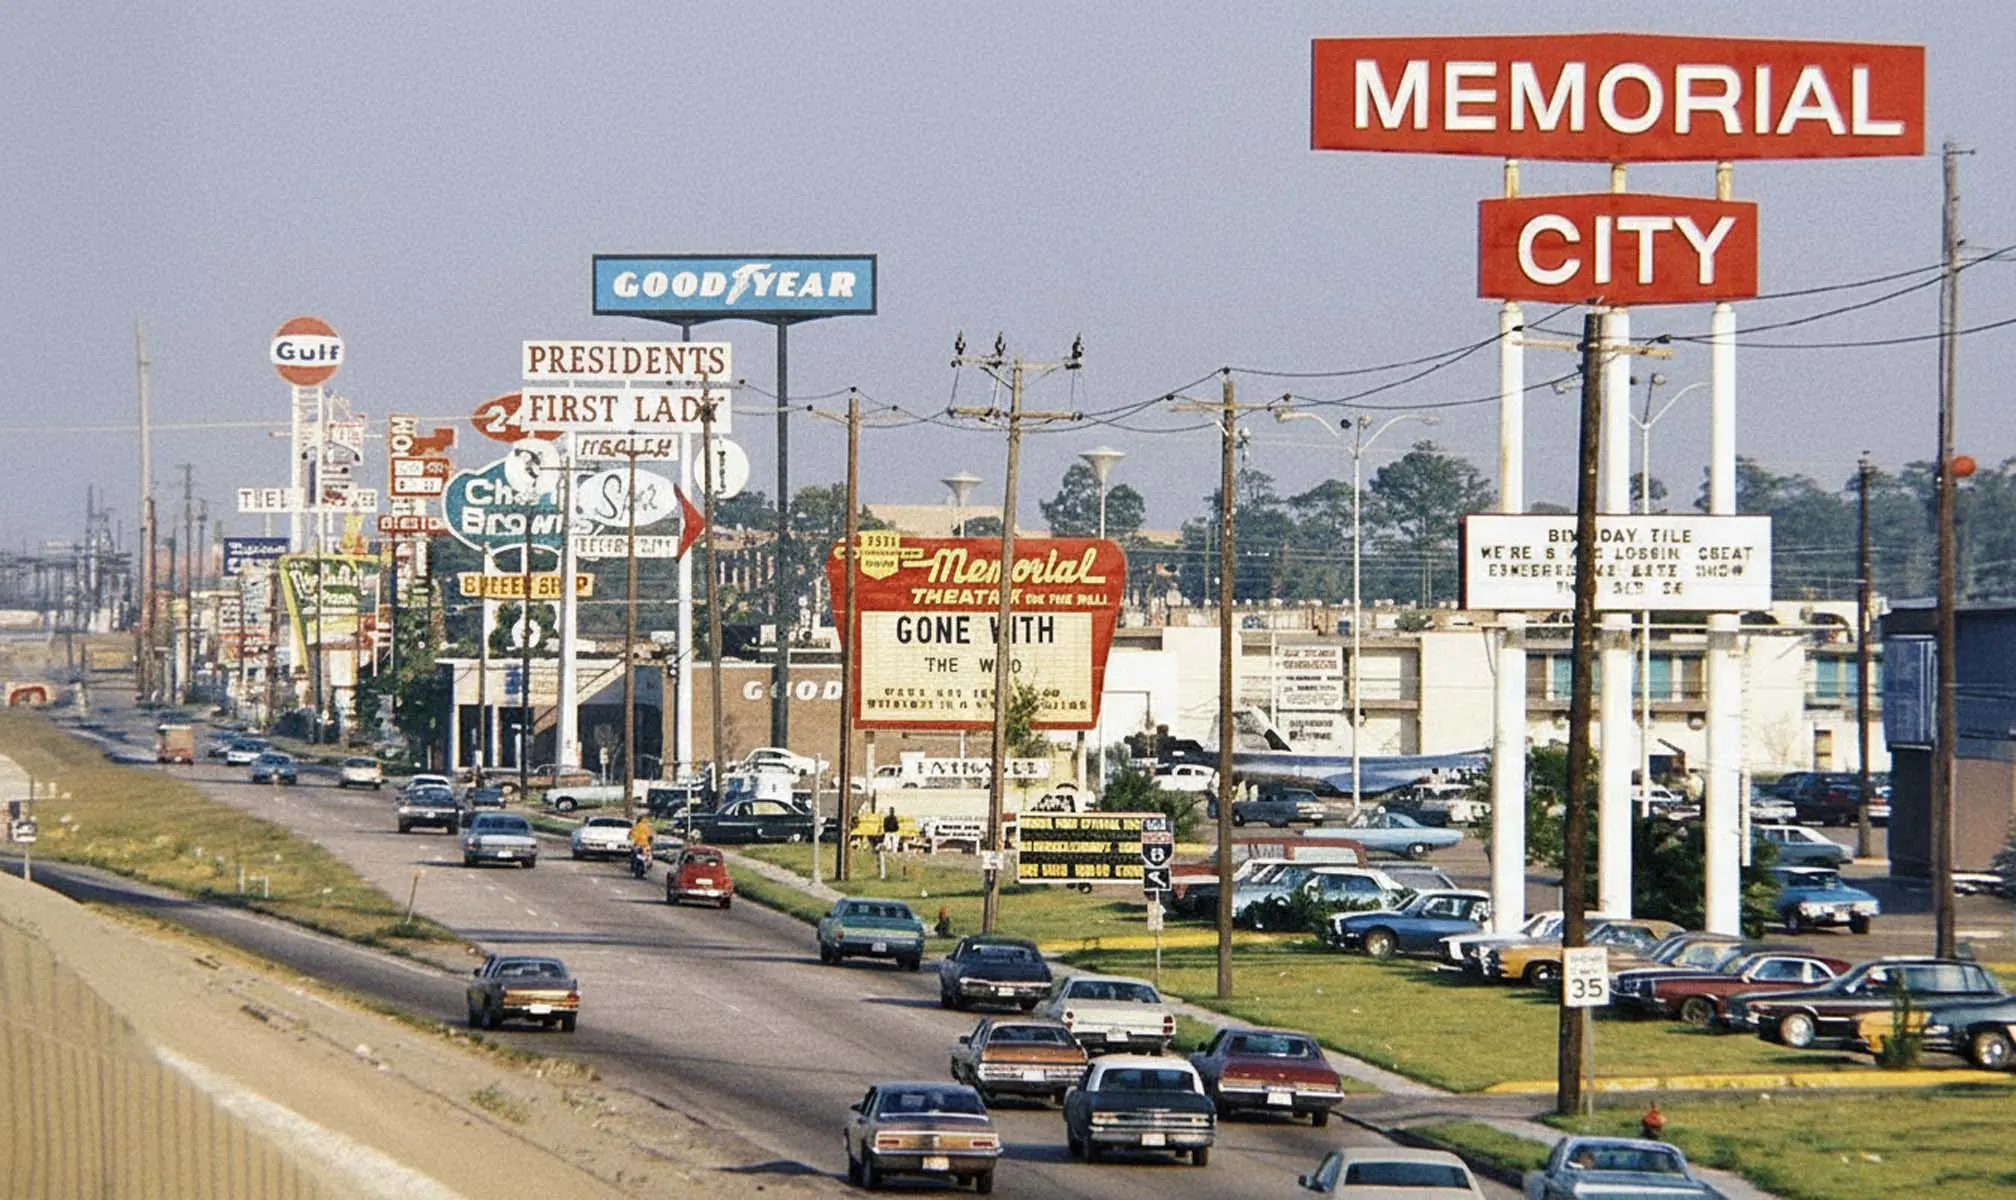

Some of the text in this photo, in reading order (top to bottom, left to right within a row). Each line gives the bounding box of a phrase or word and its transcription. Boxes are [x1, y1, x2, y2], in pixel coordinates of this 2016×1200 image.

[1354, 59, 1906, 136] MEMORIAL
[1517, 213, 1737, 286] CITY
[612, 264, 858, 305] GOODYEAR
[276, 341, 340, 361] Gulf
[528, 345, 725, 375] PRESIDENTS
[528, 395, 619, 422] FIRST
[1548, 528, 1638, 543] BIDAY
[903, 547, 1107, 584] Memorial
[896, 615, 971, 644] GONE
[924, 657, 1022, 674] THE WD
[742, 680, 843, 701] GOD
[1571, 977, 1603, 999] 35
